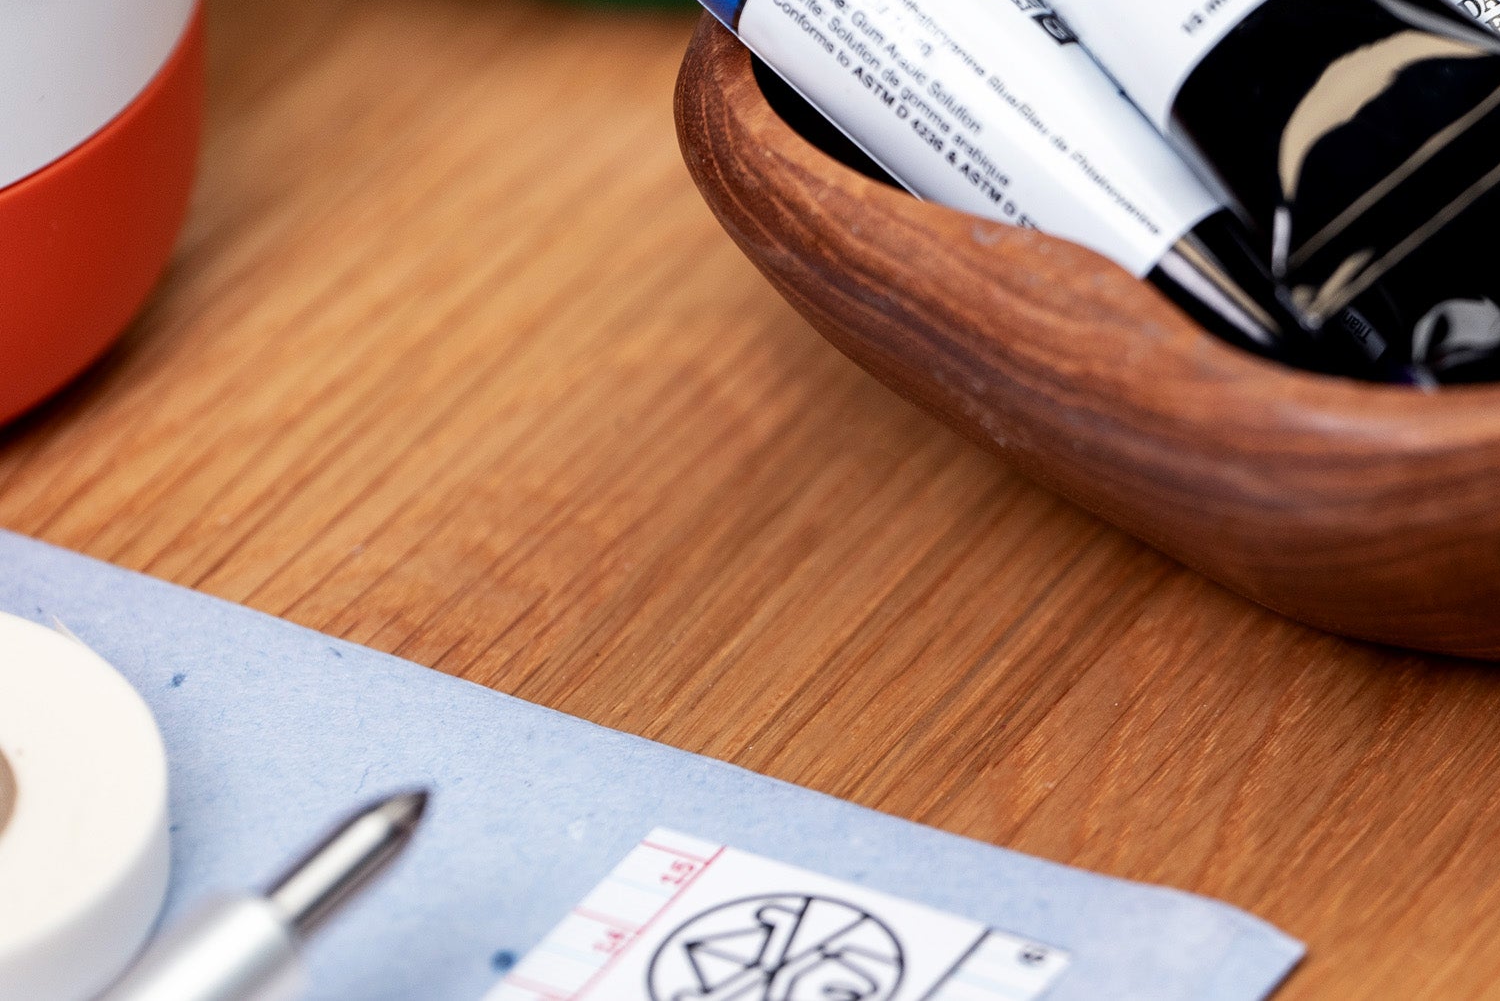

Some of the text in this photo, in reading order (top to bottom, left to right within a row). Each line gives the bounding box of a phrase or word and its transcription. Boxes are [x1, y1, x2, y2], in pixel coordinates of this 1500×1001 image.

[828, 15, 881, 71] Solution
[881, 67, 900, 87] de
[900, 86, 951, 134] gomme
[952, 132, 1011, 189] arabique
[836, 50, 851, 68] to
[851, 65, 895, 107] ASTM
[895, 104, 909, 120] D
[959, 162, 1003, 205] ASTM
[851, 10, 885, 46] Gum
[927, 79, 983, 134] Solution
